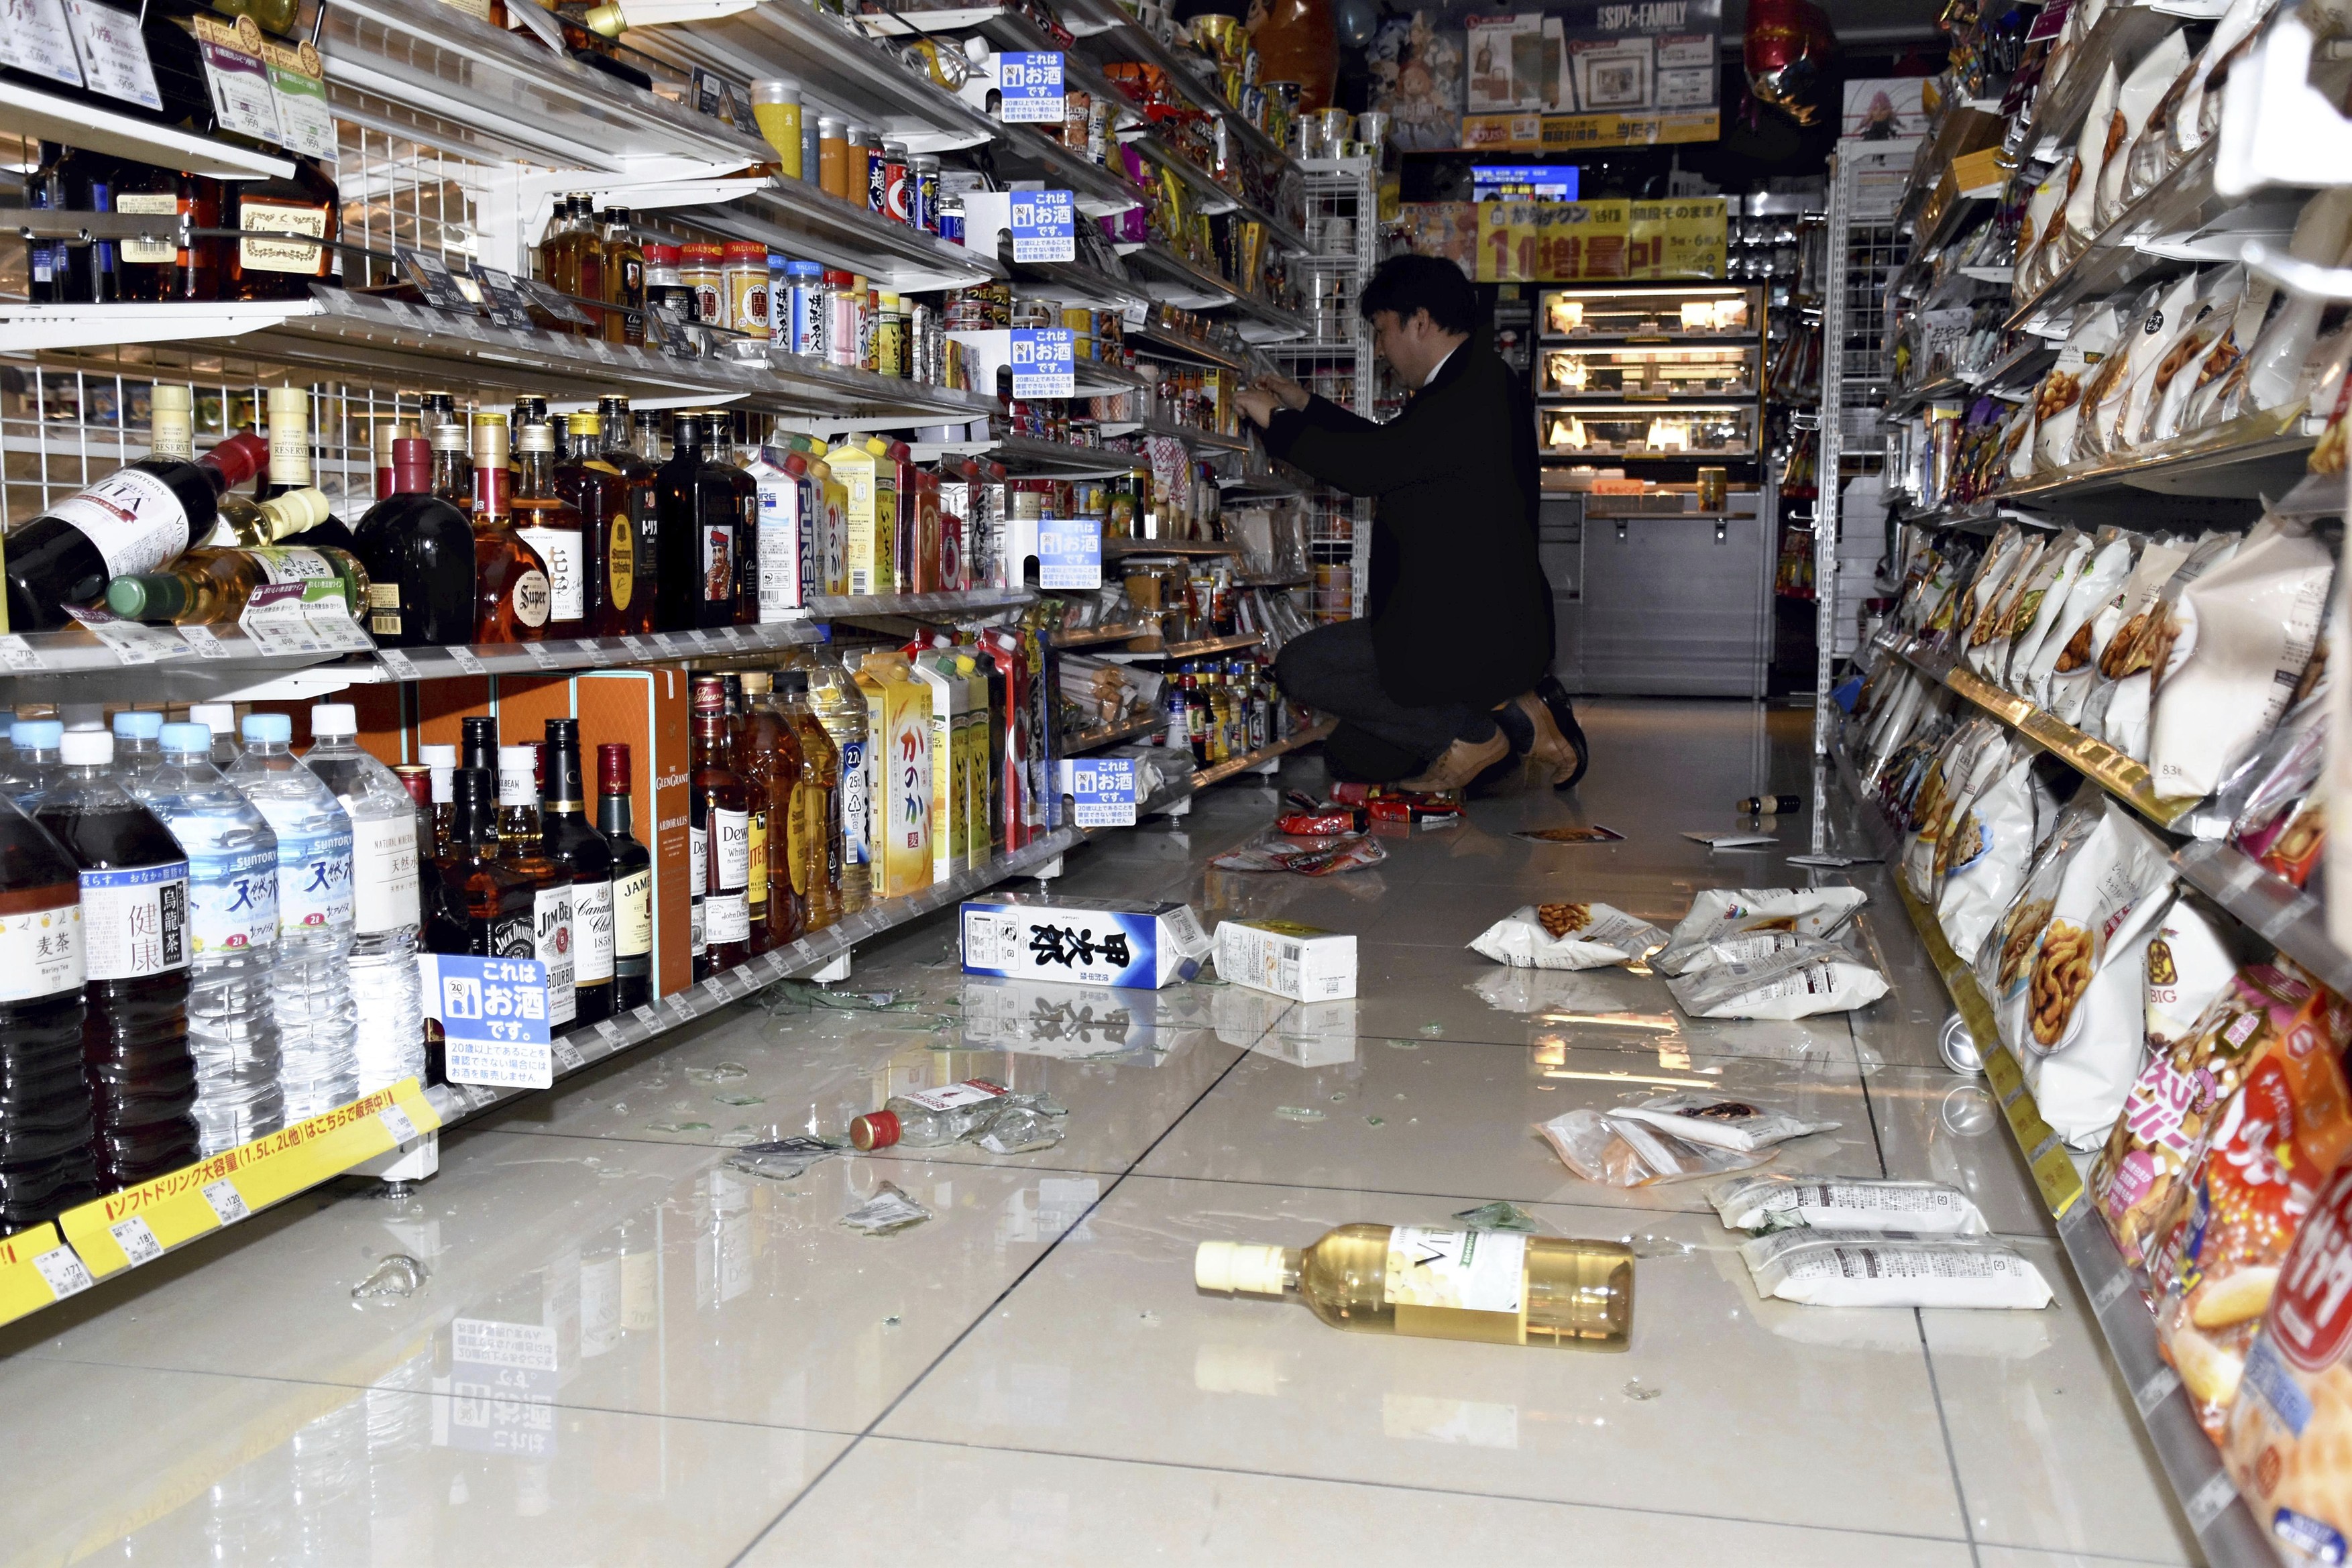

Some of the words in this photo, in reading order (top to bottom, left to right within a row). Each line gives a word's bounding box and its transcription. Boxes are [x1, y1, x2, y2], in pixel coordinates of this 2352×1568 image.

[1026, 55, 1058, 64] これは
[1026, 66, 1061, 85] お酒
[1027, 86, 1052, 97] です。
[1036, 193, 1067, 204] これは
[1036, 205, 1071, 224] お酒
[1037, 226, 1062, 237] です。
[809, 294, 823, 351] 焼酎名人
[1036, 331, 1067, 341] これは
[1036, 343, 1071, 361] お酒
[1037, 362, 1062, 373] です。
[155, 443, 190, 452] RESERVE
[274, 445, 309, 455] RESERVE
[121, 471, 168, 497] SUNTORY
[519, 583, 547, 612] Super
[847, 751, 860, 765] 2.7L
[1098, 761, 1129, 771] これは
[848, 775, 862, 789] 25%
[901, 725, 925, 826] かのか
[1098, 773, 1133, 791] お酒
[1099, 792, 1125, 802] です。
[658, 815, 688, 832] ARBORALIS
[314, 836, 353, 851] SUNTORY
[374, 839, 398, 850] NATURAL
[907, 831, 919, 848] 麦
[237, 850, 278, 869] SUNTORY
[392, 856, 418, 874] 天然水
[303, 855, 354, 893] 天然水
[225, 871, 278, 913] 天然水
[177, 883, 185, 922] サントリー
[163, 889, 180, 954] 烏龍茶
[537, 907, 559, 939] JIM
[36, 932, 70, 958] 麦茶
[127, 902, 160, 973] 健康
[495, 926, 513, 956] JACK
[594, 936, 612, 949] 1858
[1029, 923, 1131, 969] 甲次郎
[41, 966, 60, 975] Barley
[483, 962, 537, 983] これは
[547, 967, 575, 989] BOURBO
[1079, 971, 1109, 983] 焼酎甲類
[484, 984, 545, 1020] お酒
[2150, 989, 2178, 1003] BIG
[486, 1020, 531, 1041] です。
[451, 1043, 547, 1058] 20歳以上であることを
[451, 1055, 547, 1070] 確認できない場合には
